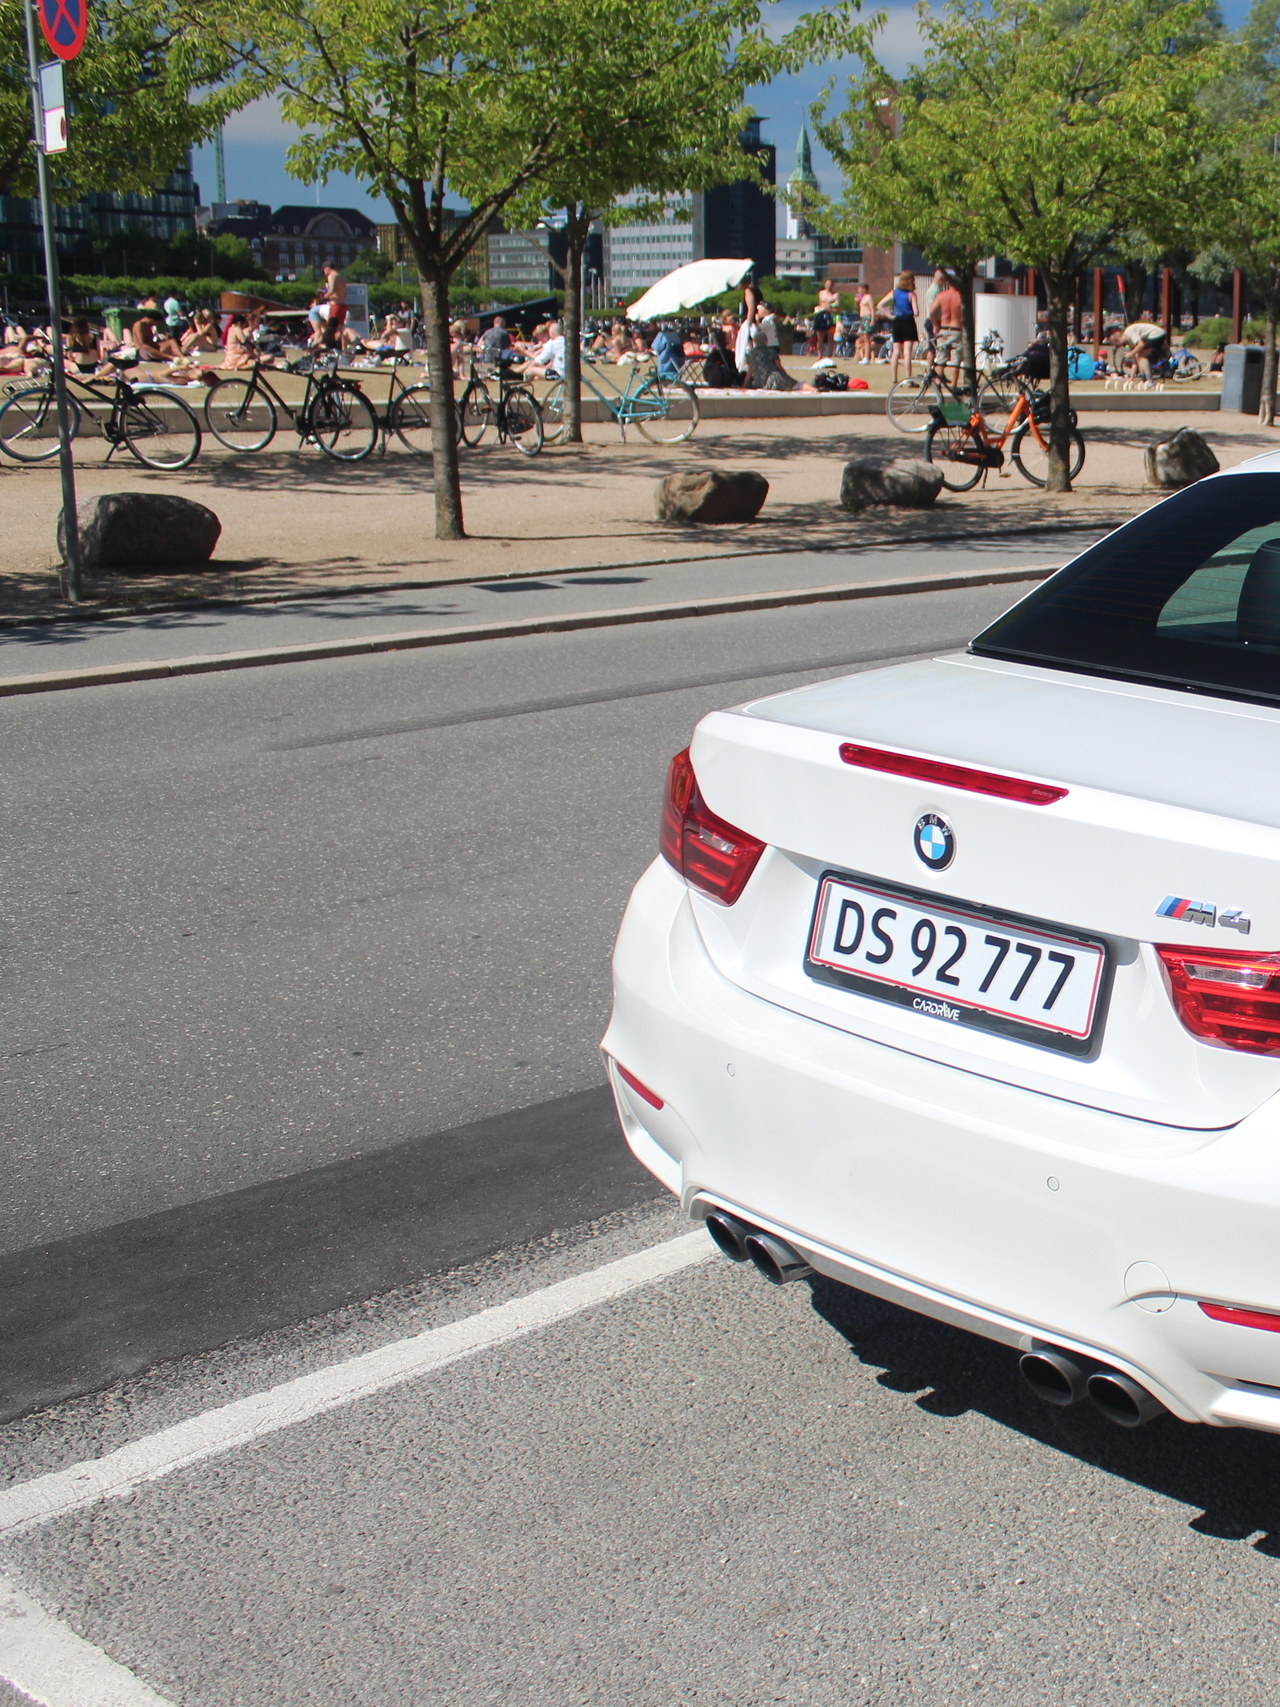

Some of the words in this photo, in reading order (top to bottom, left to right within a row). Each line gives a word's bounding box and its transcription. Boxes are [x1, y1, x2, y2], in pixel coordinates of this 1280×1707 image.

[917, 814, 954, 838] BMW
[1180, 900, 1252, 936] M4
[833, 897, 898, 965] DS
[910, 918, 968, 987] 92
[978, 935, 1076, 1011] 777
[912, 997, 961, 1022] CARDRIVE
